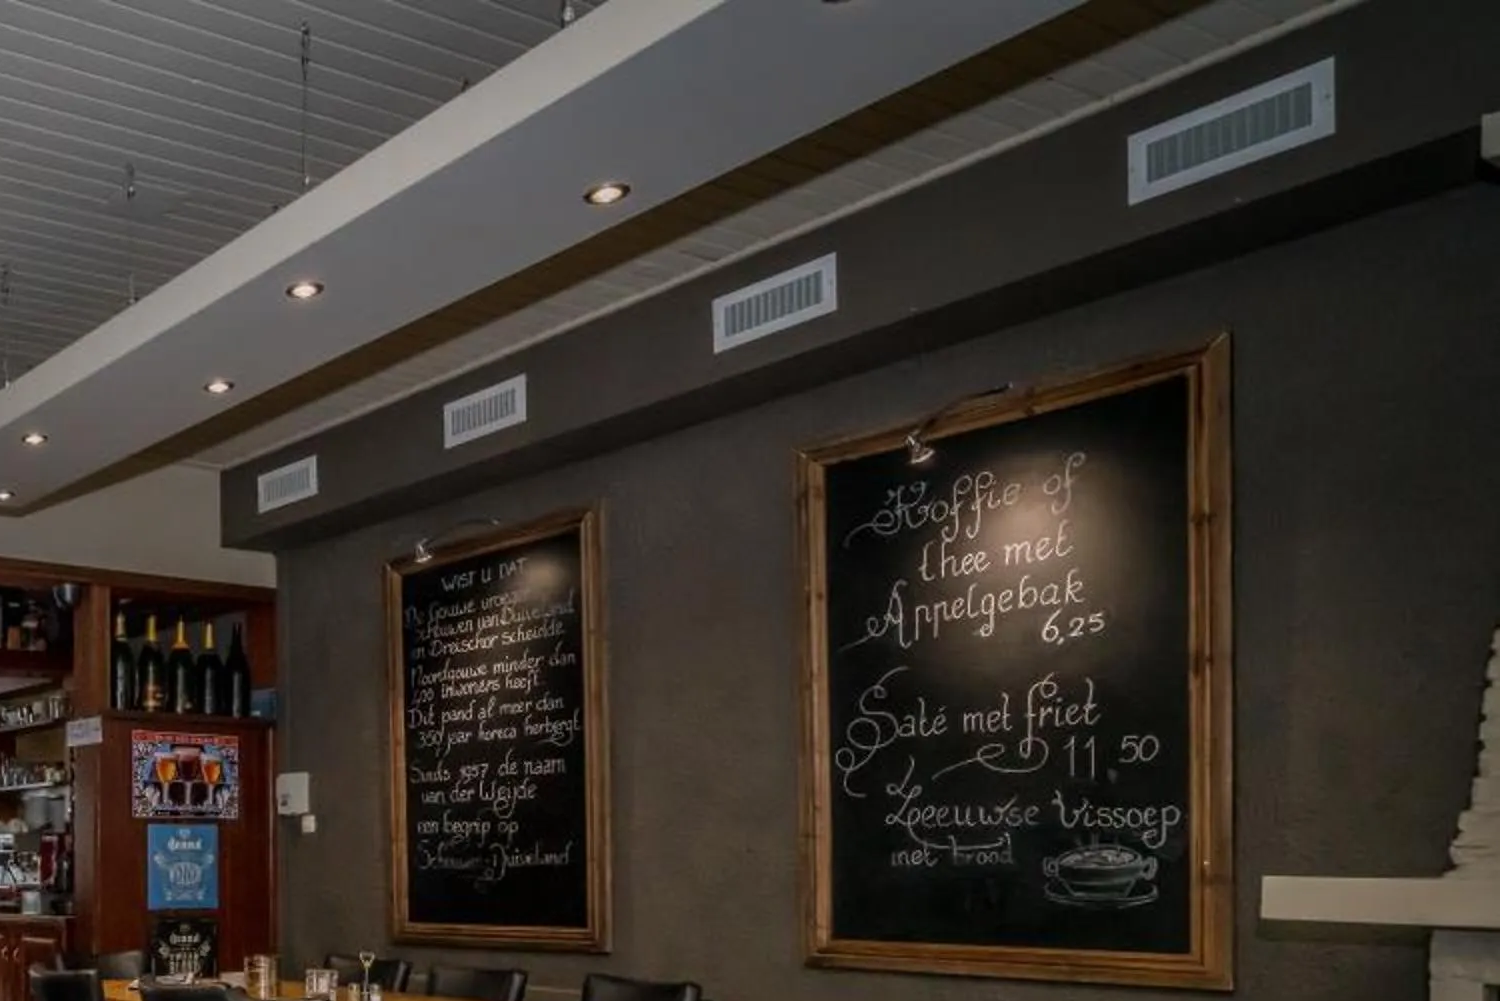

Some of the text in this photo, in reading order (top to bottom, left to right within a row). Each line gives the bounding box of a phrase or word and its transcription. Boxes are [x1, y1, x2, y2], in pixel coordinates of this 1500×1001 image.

[843, 451, 1086, 547] Koffie of
[440, 556, 527, 593] WIST U DAT
[918, 519, 1074, 582] thee met
[850, 567, 1085, 650] Appelgebak
[1041, 608, 1106, 646] 6,25
[835, 666, 1101, 776] Saté met friet
